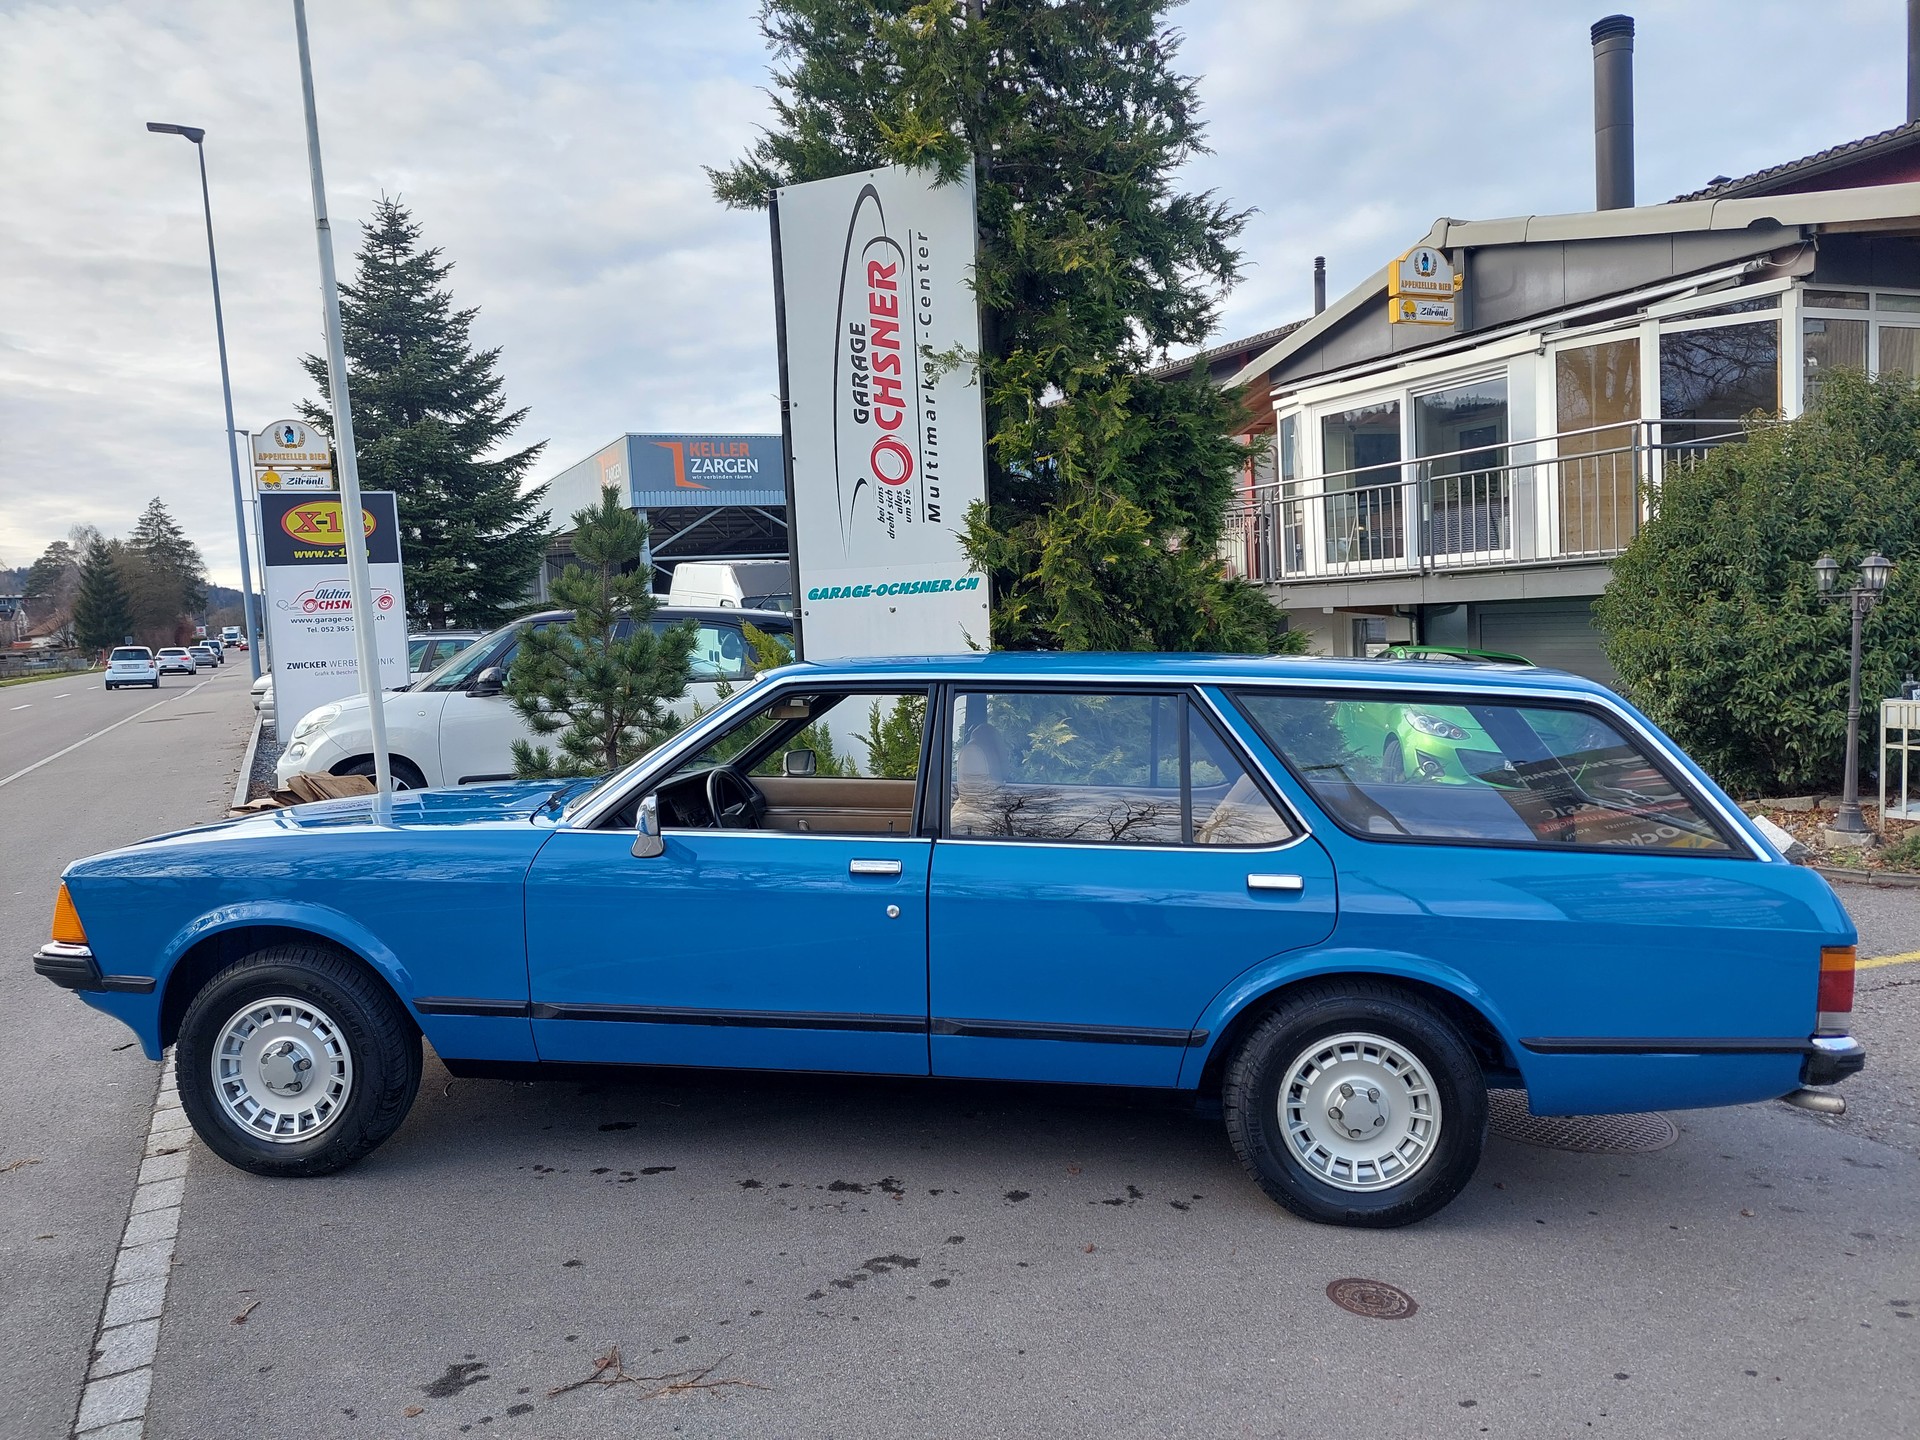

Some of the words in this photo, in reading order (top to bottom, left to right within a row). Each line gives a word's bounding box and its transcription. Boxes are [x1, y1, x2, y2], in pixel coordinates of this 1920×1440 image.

[1401, 280, 1437, 290] APPENZELLER
[1439, 282, 1452, 291] BIER
[850, 322, 870, 425] GARAGE
[867, 260, 914, 485] OCHSNER
[258, 453, 307, 461] APPENZELLER
[309, 452, 327, 460] BIER
[689, 442, 750, 457] KELLER
[690, 458, 759, 474] ZARGEN
[286, 476, 325, 486] Zitrönli
[885, 489, 894, 511] sich
[896, 490, 904, 514] alles
[903, 489, 911, 507] Sie
[293, 511, 371, 533] X-1
[877, 507, 885, 523] bei
[905, 508, 912, 523] um
[885, 512, 896, 539] dreht
[807, 577, 980, 601] GARAGE-OCHSNER.CH
[287, 661, 327, 670] ZWICKER
